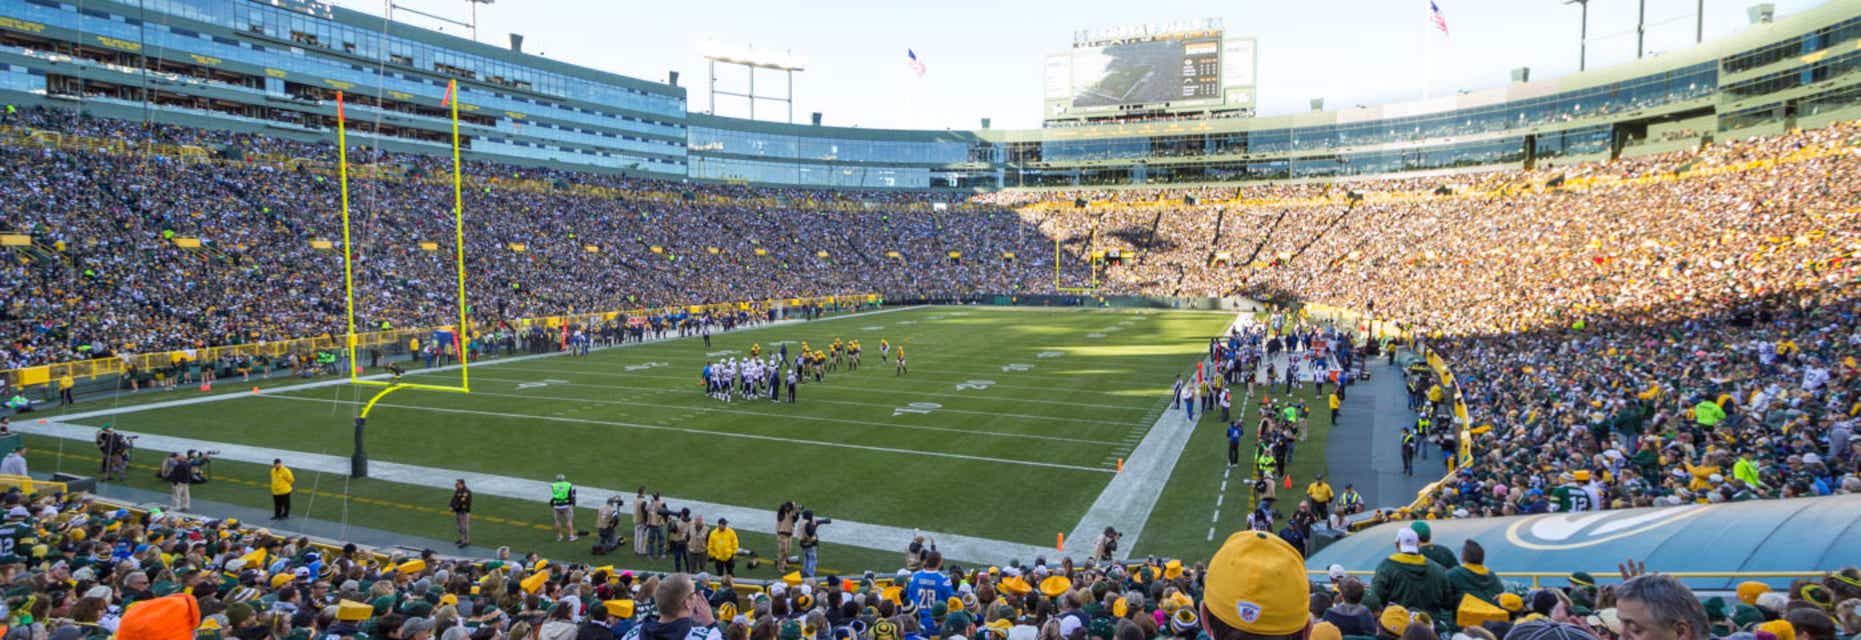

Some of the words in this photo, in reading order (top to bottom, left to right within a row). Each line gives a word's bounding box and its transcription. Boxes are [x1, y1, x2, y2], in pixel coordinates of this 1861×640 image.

[892, 402, 943, 416] 10
[1568, 496, 1588, 512] 12
[918, 588, 936, 609] 28
